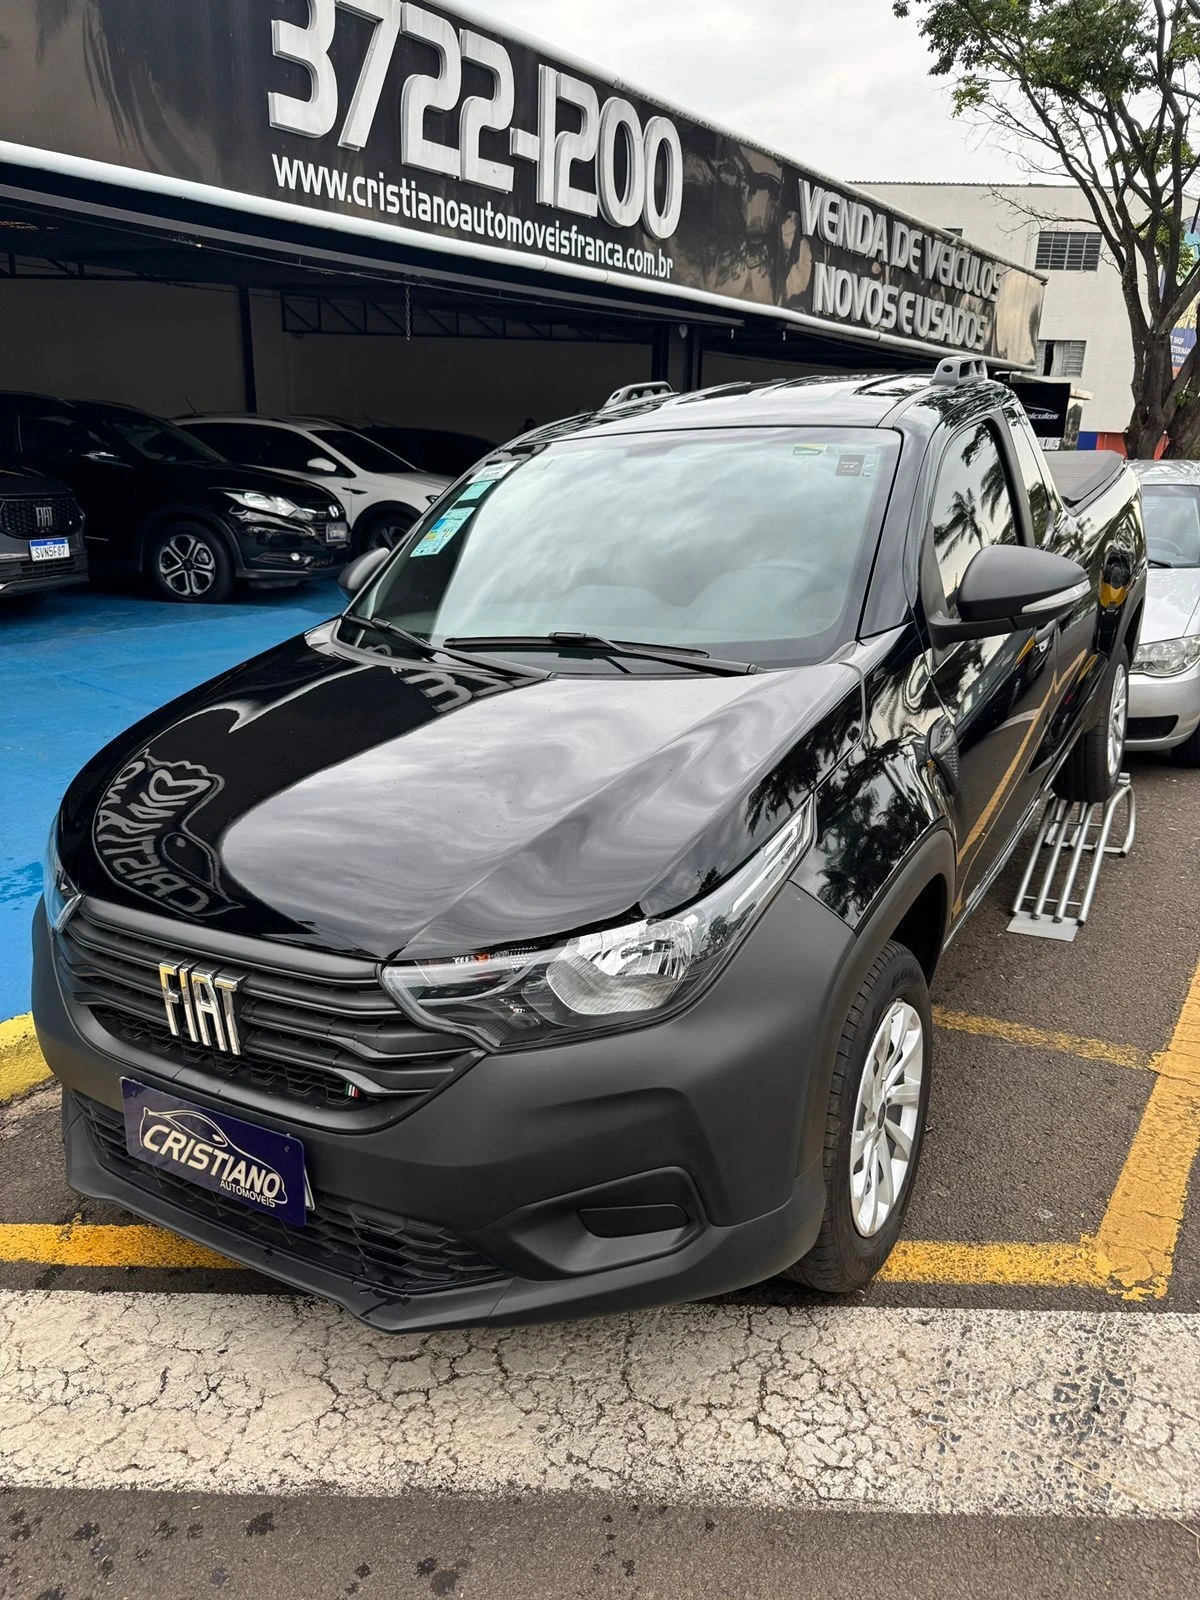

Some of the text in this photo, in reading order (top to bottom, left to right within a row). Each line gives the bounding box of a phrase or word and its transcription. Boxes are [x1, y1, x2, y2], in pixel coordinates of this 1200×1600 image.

[268, 0, 684, 240] 3722-1200
[271, 153, 674, 280] www.cristianoautomoveisfranca.com.br
[798, 178, 889, 263] VENDA
[890, 220, 925, 275] DE
[812, 262, 988, 351] NOVOS E USADOS
[35, 506, 53, 527] FIAT
[158, 961, 242, 1056] FIAT
[143, 1124, 281, 1198] CRISTIANO
[219, 1179, 276, 1208] AUTOMOVEIS
